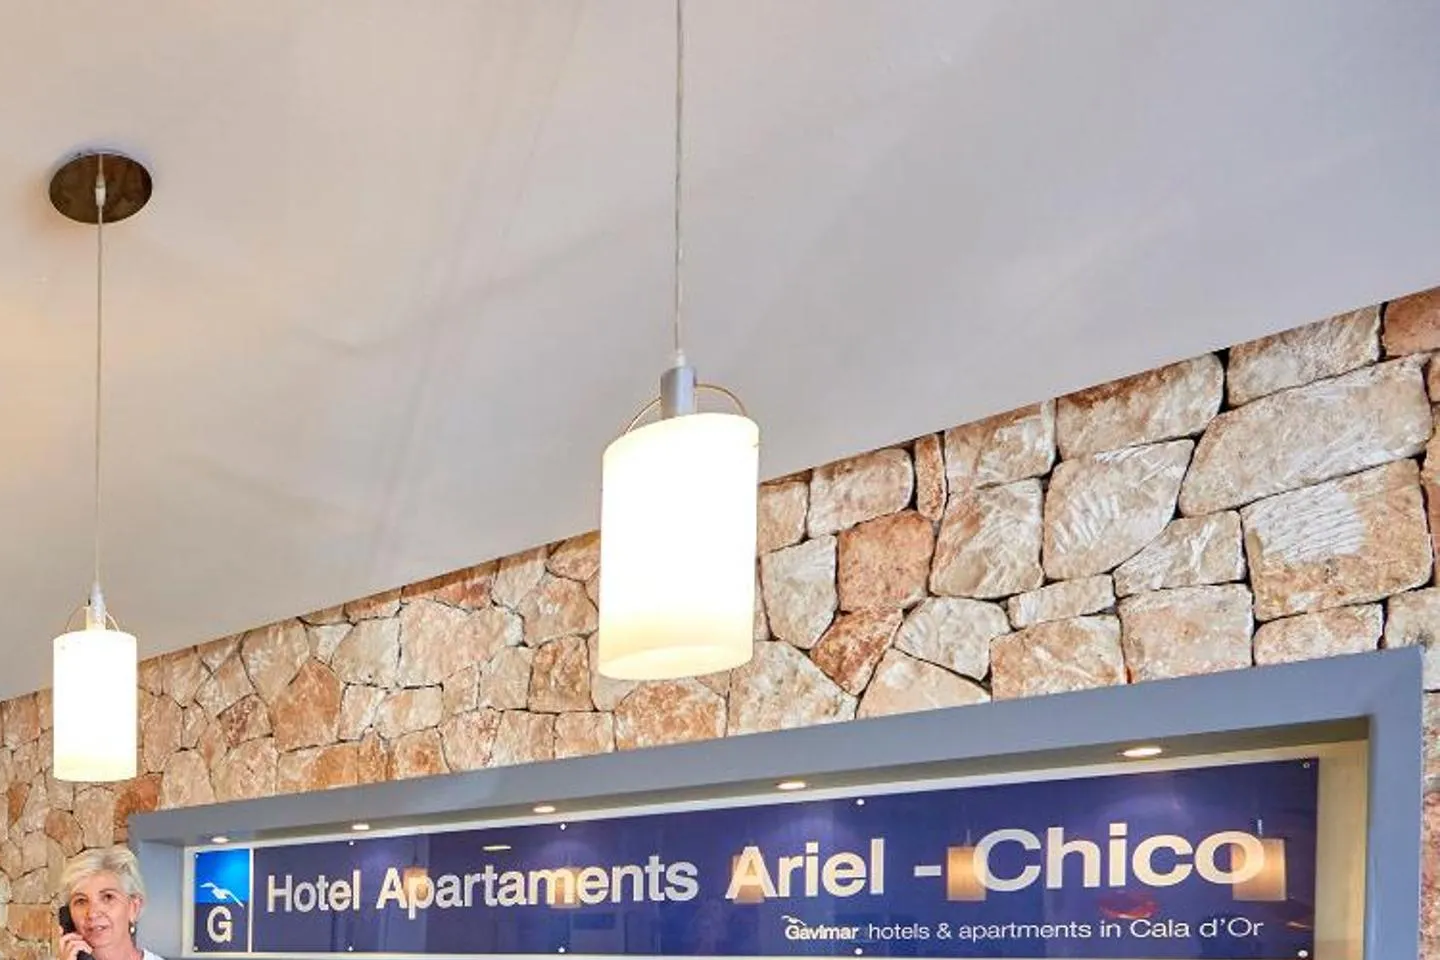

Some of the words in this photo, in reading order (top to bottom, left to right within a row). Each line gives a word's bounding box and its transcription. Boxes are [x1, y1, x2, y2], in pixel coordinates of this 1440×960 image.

[267, 870, 360, 913] Hotel
[376, 854, 698, 919] Apartaments
[725, 838, 885, 900] Ariel
[913, 864, 942, 877] -
[972, 822, 1265, 892] Chico
[206, 906, 233, 944] G
[784, 923, 859, 940] Gavimar
[868, 922, 931, 940] hotels
[936, 922, 953, 940] &
[959, 920, 1092, 942] apartments
[1099, 919, 1122, 938] in
[1129, 918, 1190, 938] Cala
[1199, 917, 1265, 938] d'Or
